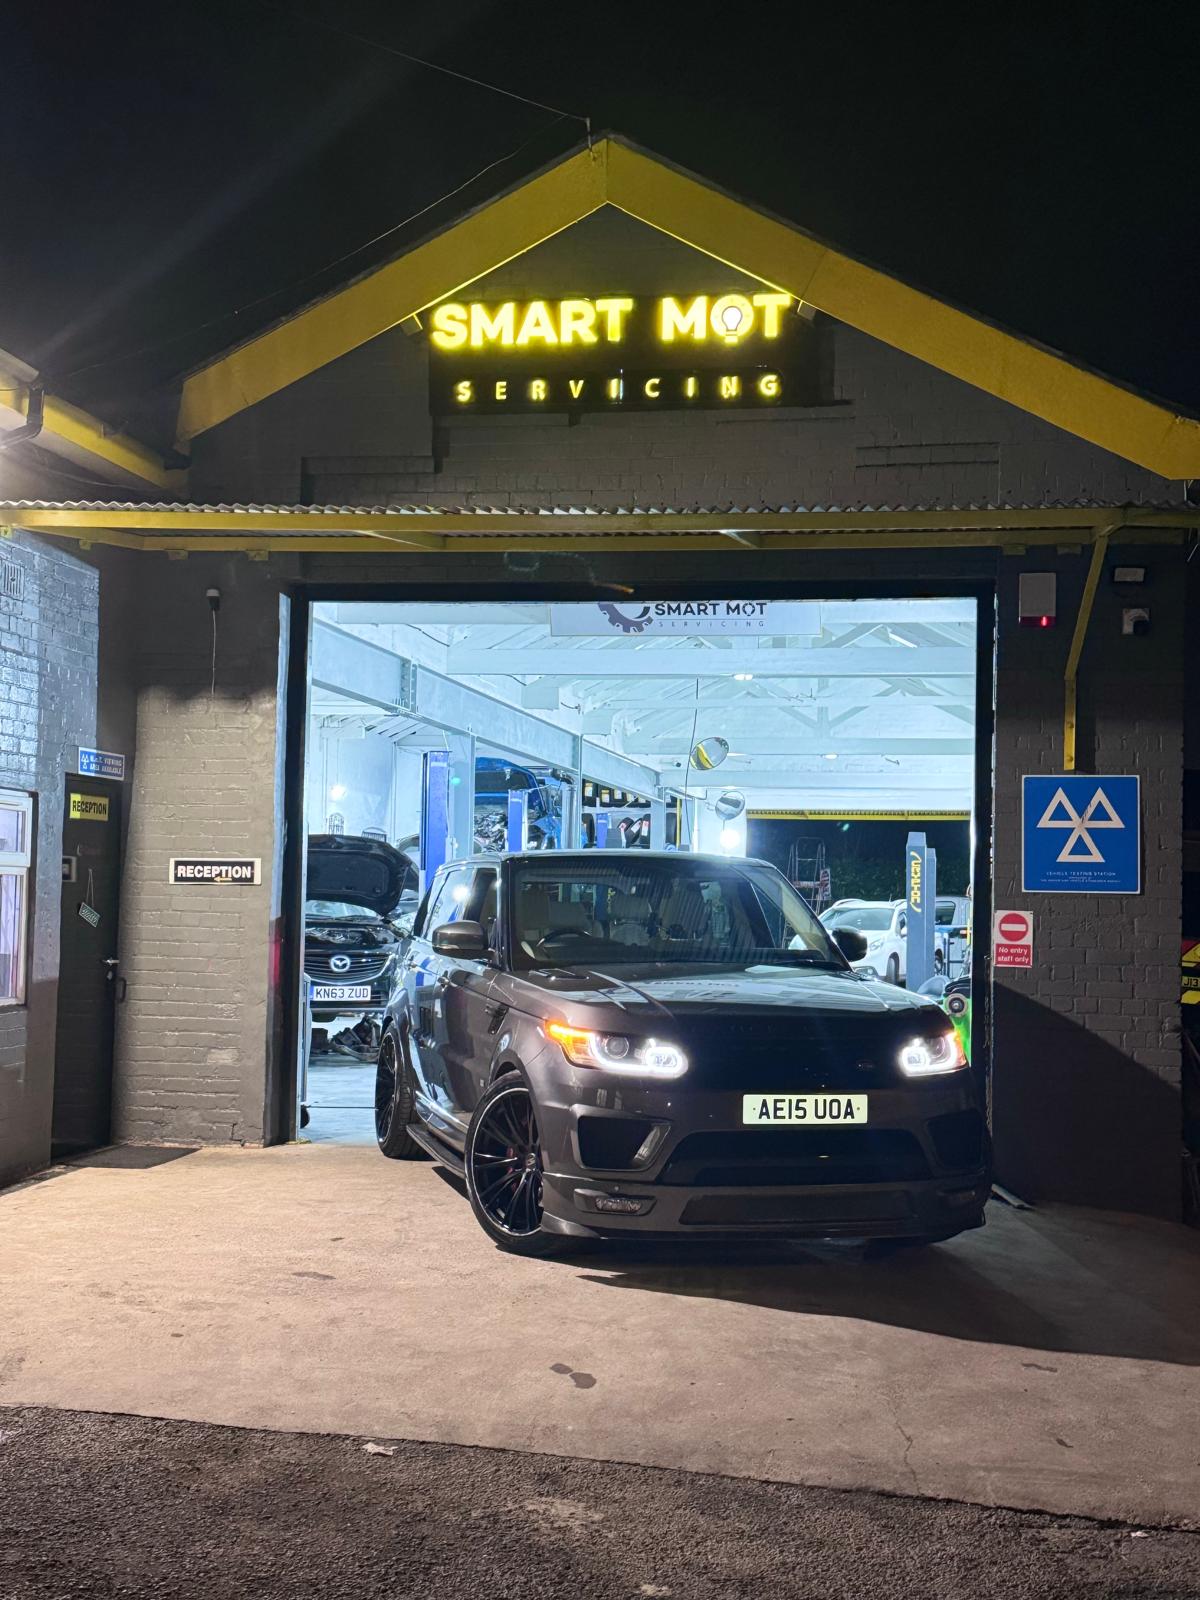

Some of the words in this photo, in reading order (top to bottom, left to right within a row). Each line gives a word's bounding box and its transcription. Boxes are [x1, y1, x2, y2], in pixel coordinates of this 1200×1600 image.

[432, 298, 633, 348] SMART
[661, 294, 790, 343] MOT
[457, 374, 779, 402] SERVICING
[654, 602, 720, 616] SMART
[726, 602, 767, 616] MOT
[659, 620, 765, 628] SERVICING
[72, 800, 107, 815] RECEPTION
[177, 865, 252, 879] RECEPTION
[1015, 956, 1029, 964] only
[315, 988, 345, 999] KN63
[347, 988, 369, 999] ZUD
[758, 1099, 807, 1119] AE15
[814, 1099, 855, 1119] UOA
